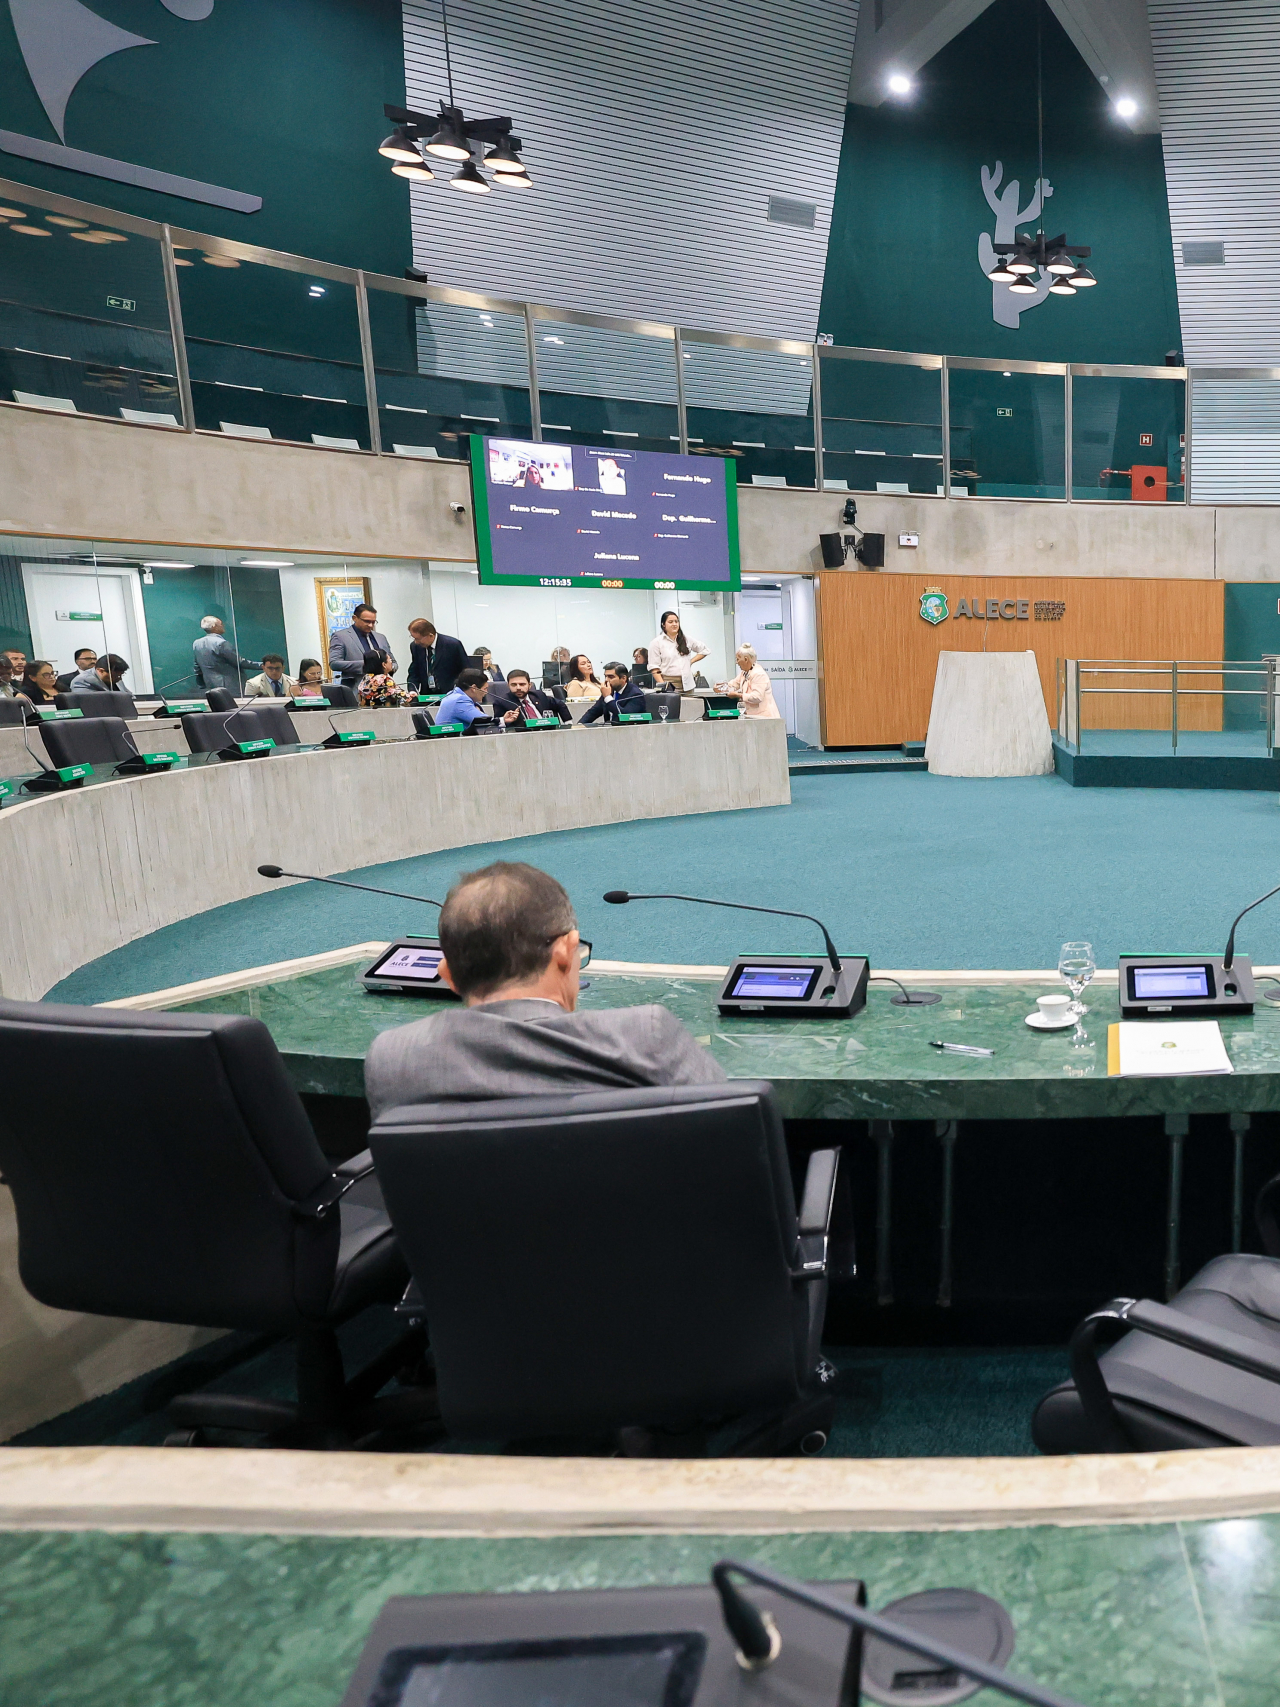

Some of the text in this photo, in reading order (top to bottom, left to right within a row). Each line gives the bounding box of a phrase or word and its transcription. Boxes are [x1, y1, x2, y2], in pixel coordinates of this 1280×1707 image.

[663, 473, 712, 484] Fernando Hugo
[509, 504, 530, 513] Firmo
[591, 510, 610, 518] David
[594, 552, 640, 561] Juliana Lucena
[539, 578, 572, 586] 12:15:35
[654, 581, 676, 589] 00:00
[953, 598, 1029, 620] ALECE
